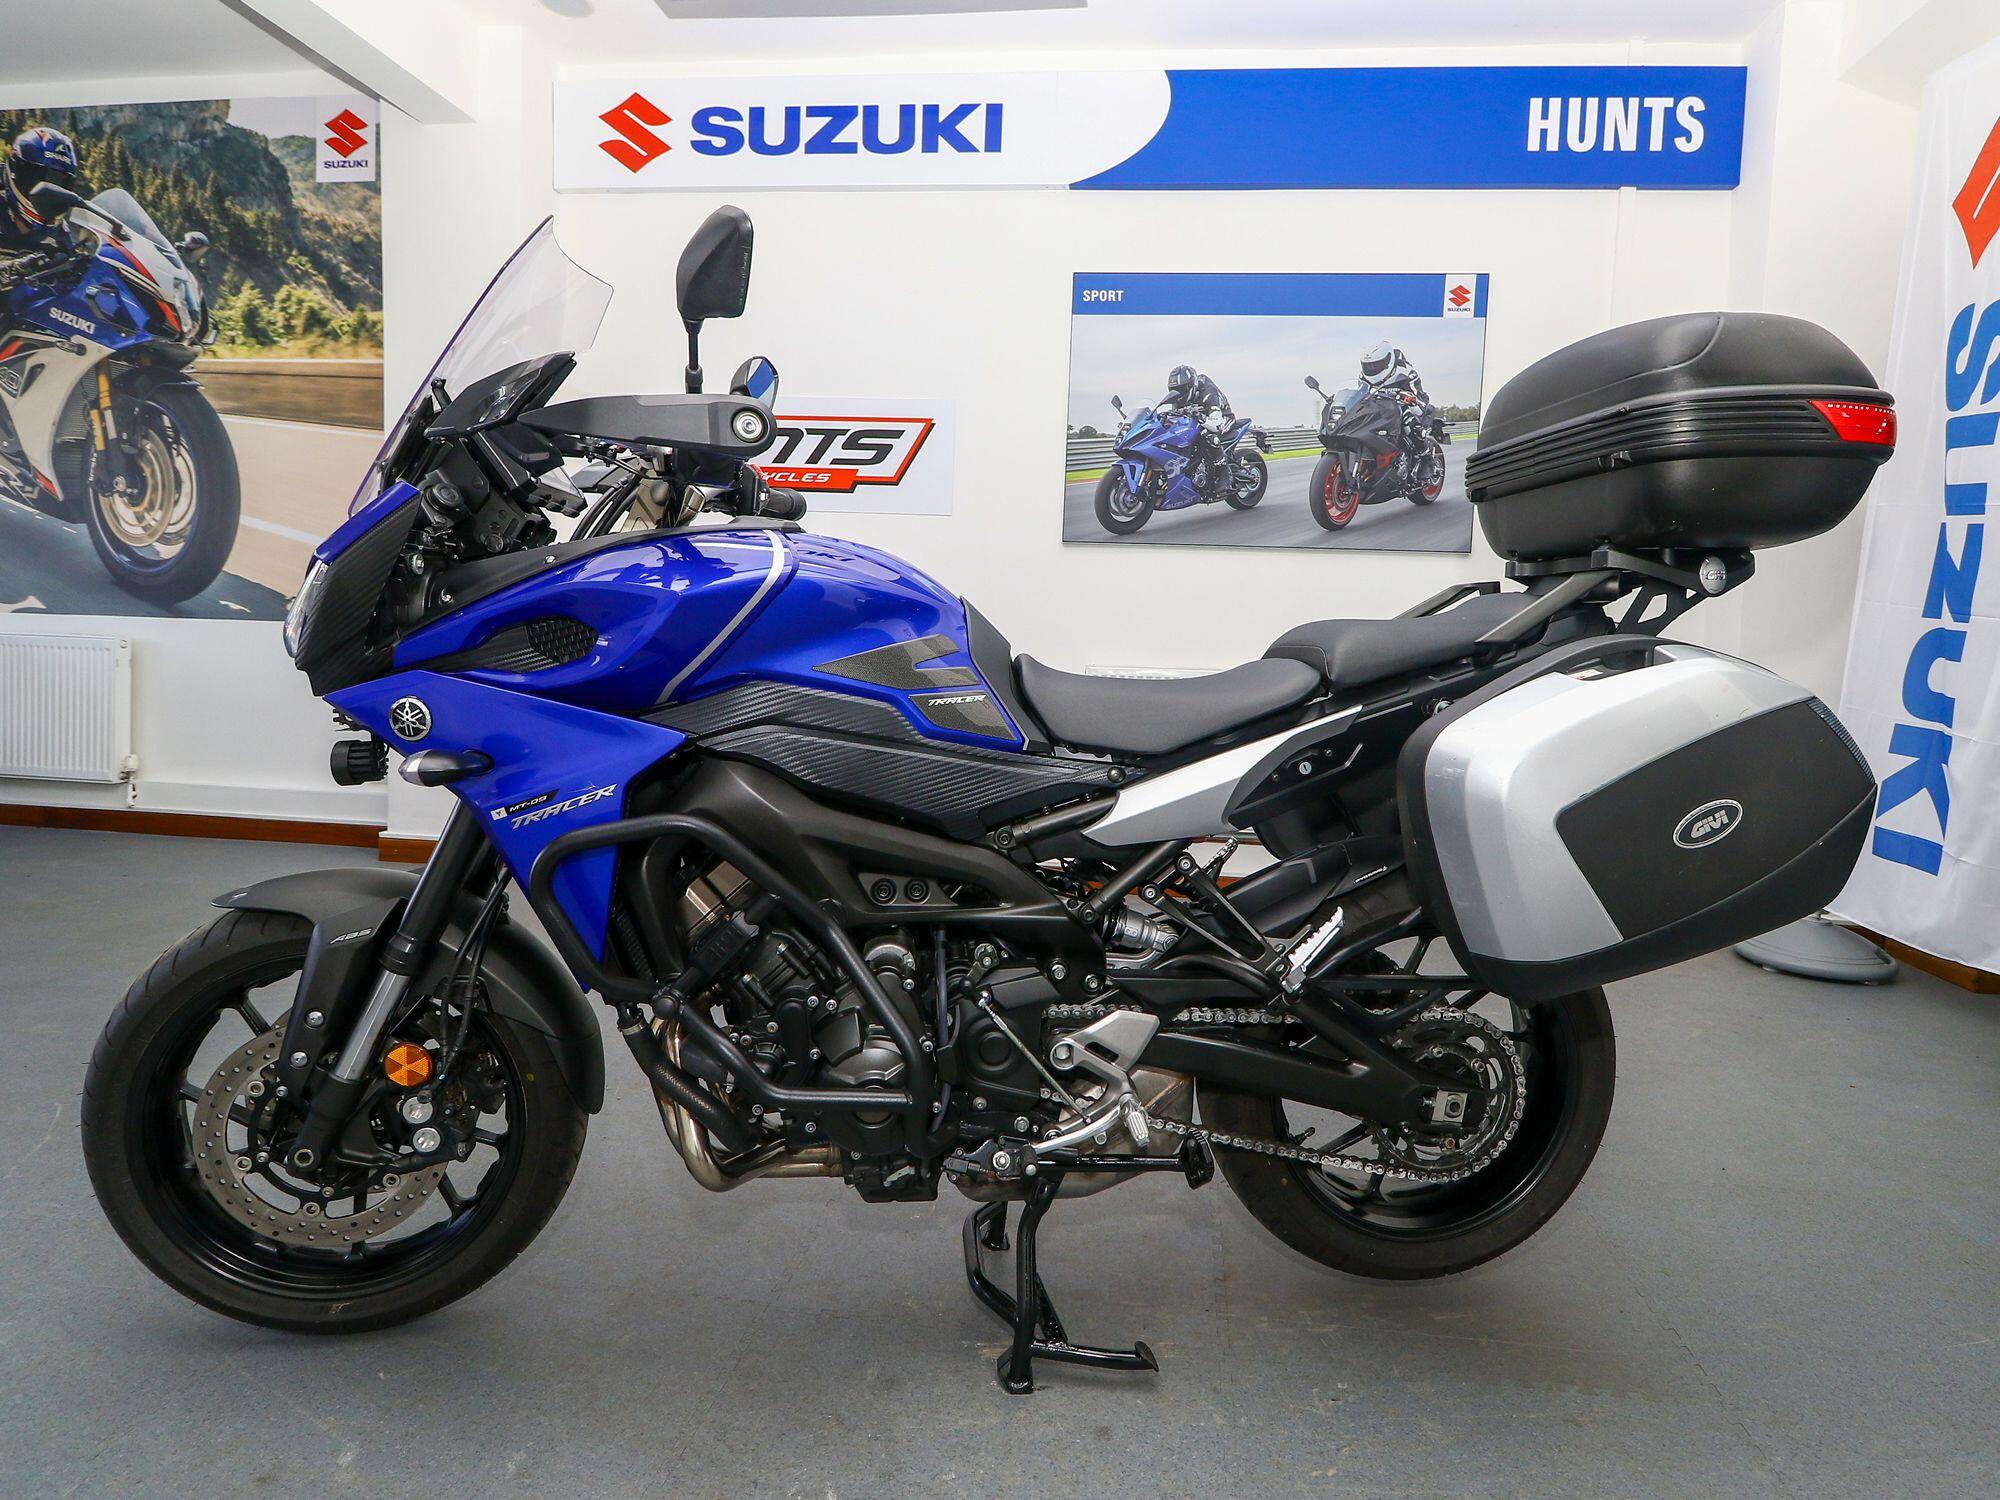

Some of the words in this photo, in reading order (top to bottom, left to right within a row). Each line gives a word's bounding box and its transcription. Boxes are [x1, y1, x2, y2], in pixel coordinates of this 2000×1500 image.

[690, 103, 1004, 156] SUZUKI
[1527, 96, 1706, 153] HUNTS
[323, 160, 368, 169] SUZUKI
[1082, 290, 1124, 302] SPORT
[48, 306, 96, 335] SUZUKI
[1872, 298, 2000, 878] SUZUKI
[928, 694, 987, 707] TRACER
[509, 795, 548, 813] MT-09
[511, 783, 618, 830] TRACER
[1690, 809, 1729, 839] GIVI
[329, 928, 372, 944] ABS
